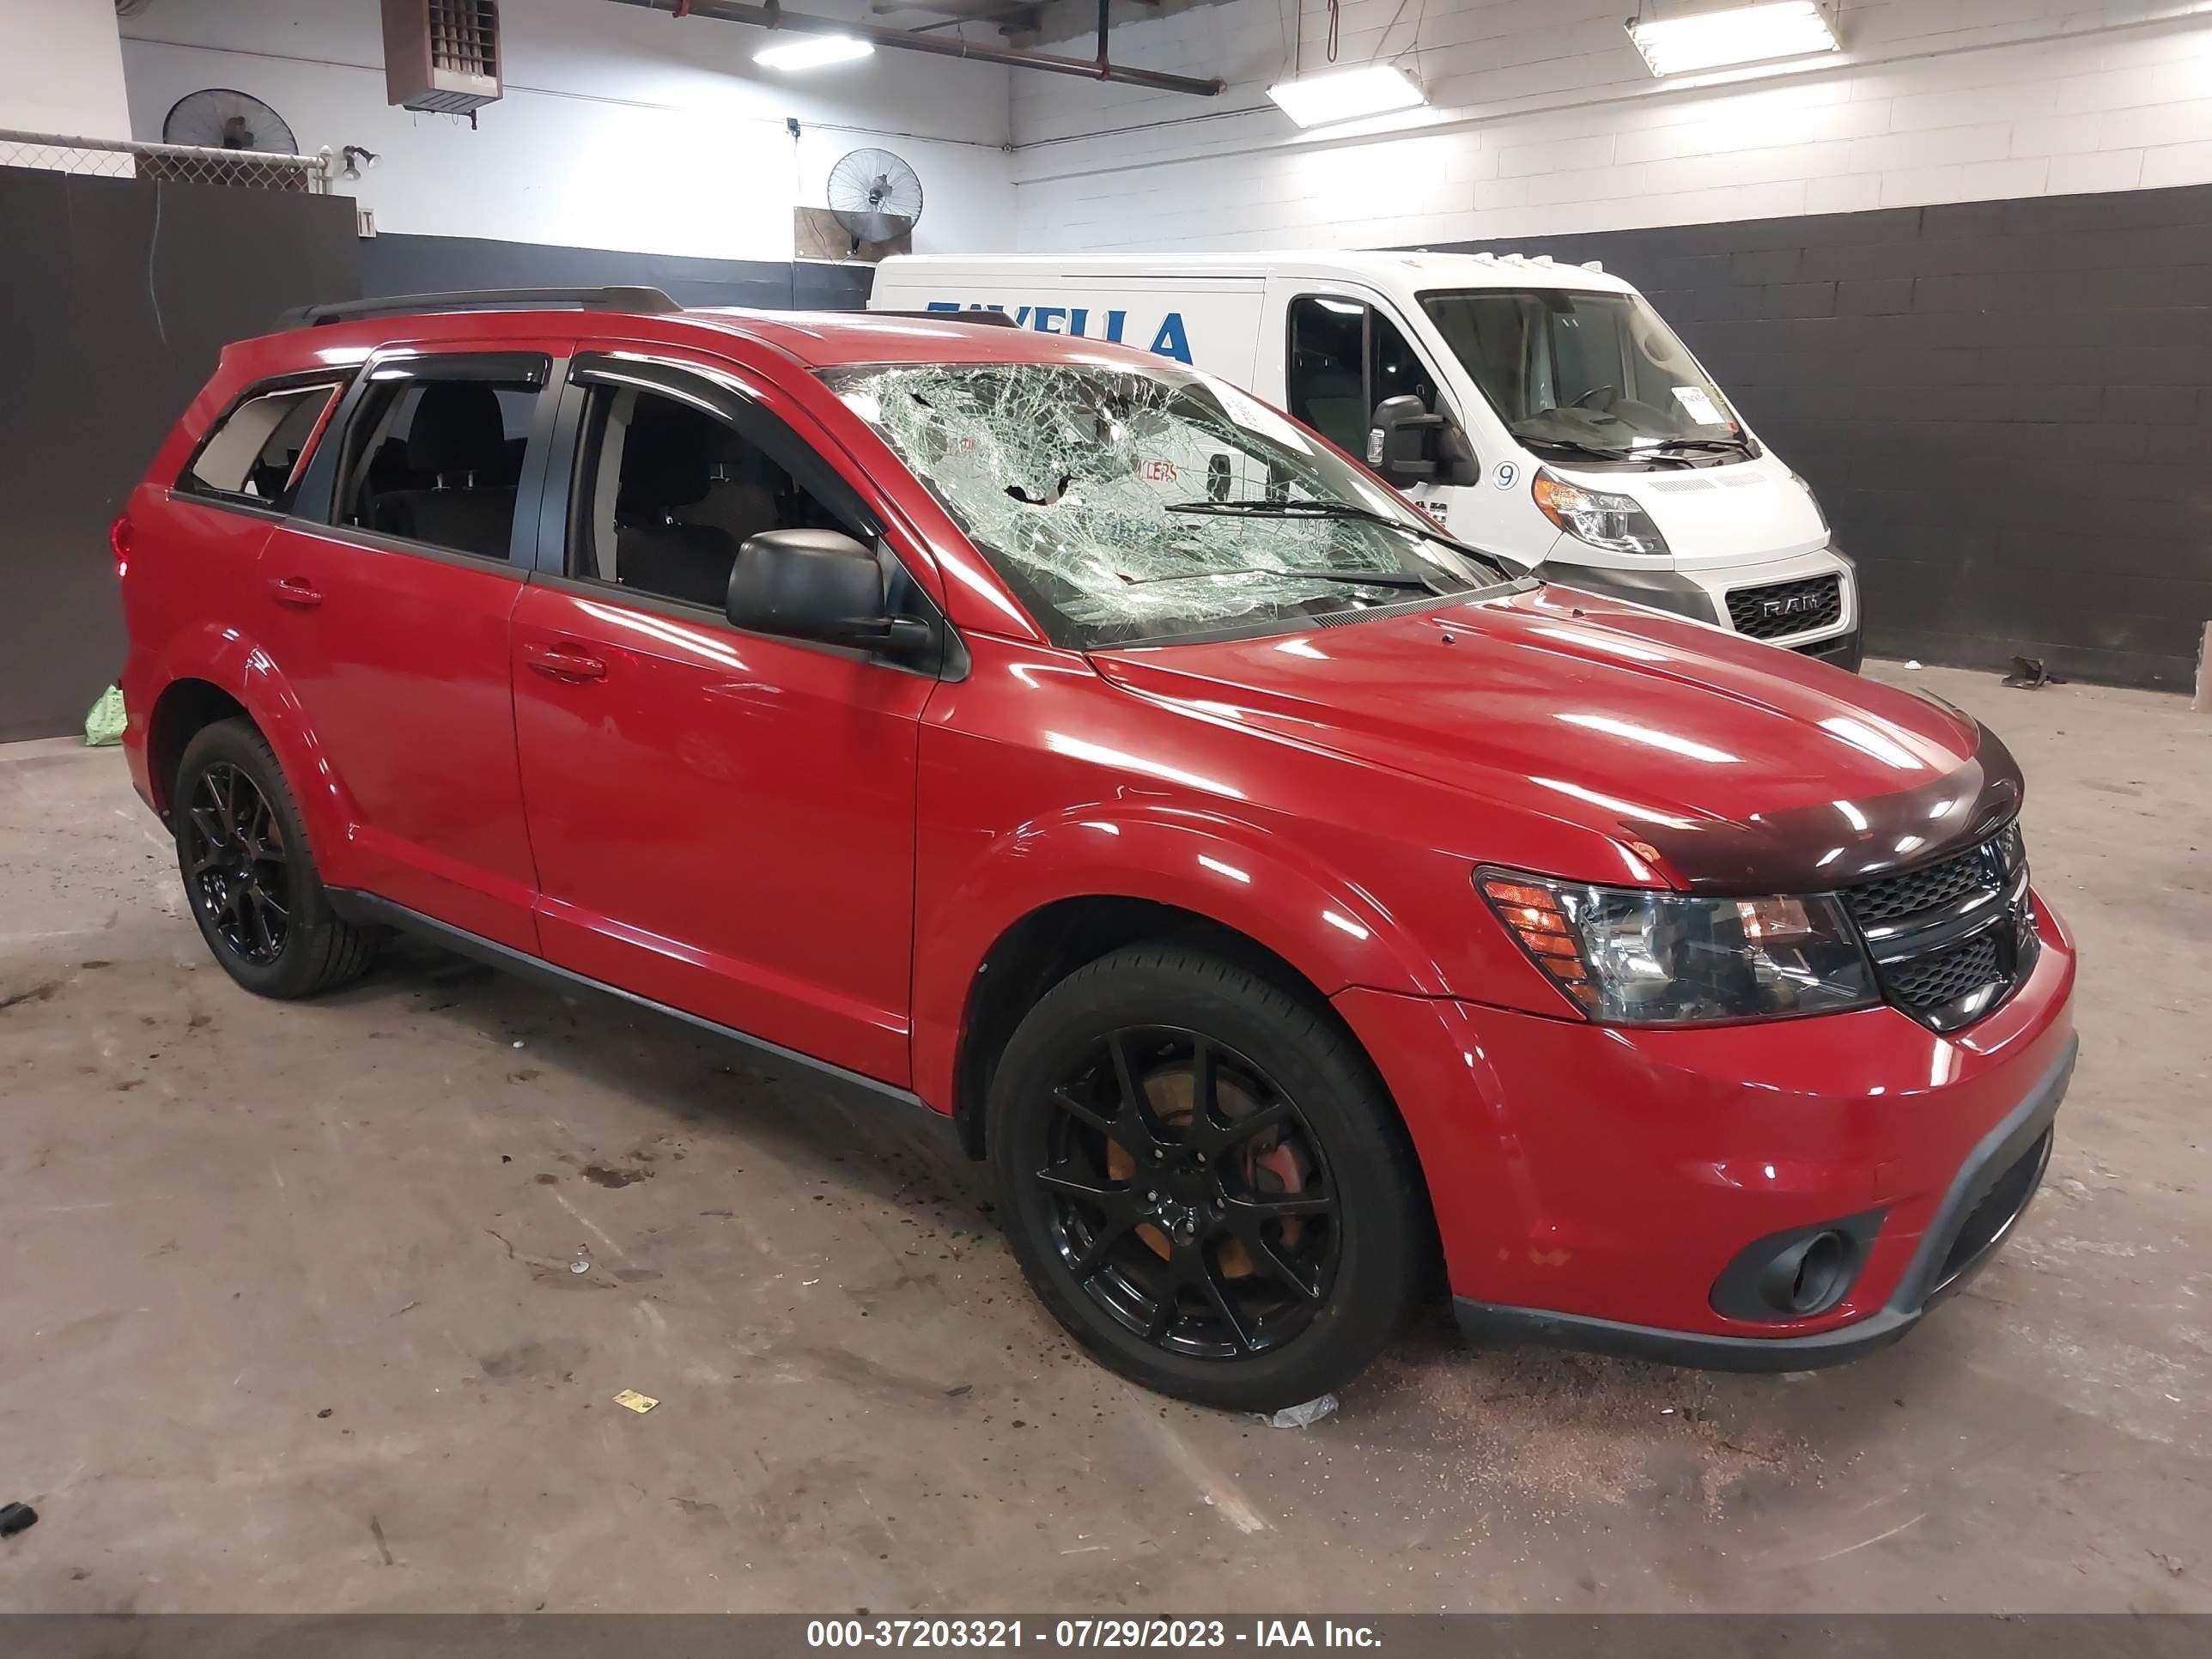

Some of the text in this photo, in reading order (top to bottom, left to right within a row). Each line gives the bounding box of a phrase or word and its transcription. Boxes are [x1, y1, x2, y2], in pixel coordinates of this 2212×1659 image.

[927, 301, 1194, 367] ELLA
[1498, 465, 1514, 487] 9
[1763, 594, 1820, 617] RAM
